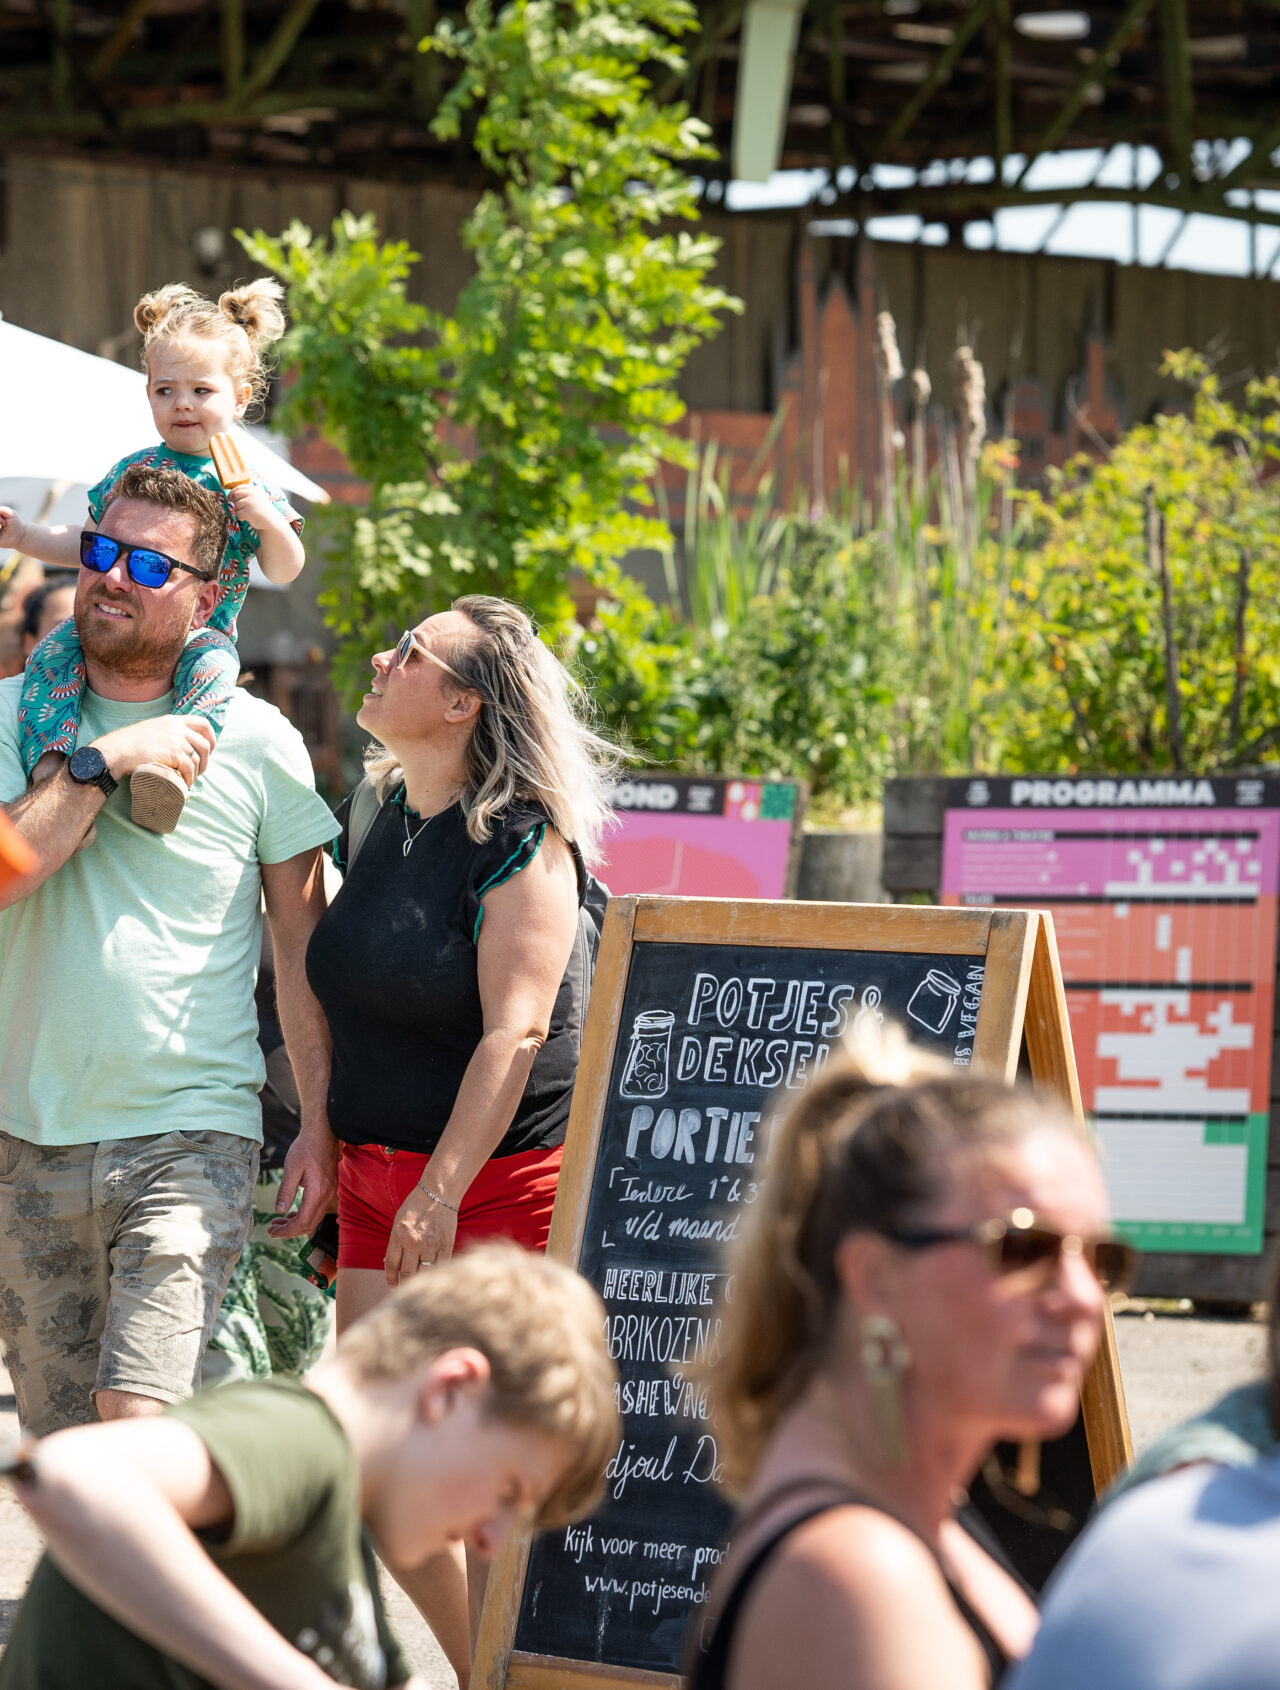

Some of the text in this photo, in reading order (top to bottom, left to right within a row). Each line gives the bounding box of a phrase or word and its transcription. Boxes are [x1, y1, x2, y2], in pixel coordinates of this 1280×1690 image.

[1011, 780, 1217, 806] PROGRAMMA
[958, 965, 985, 1038] VEGAN
[603, 1268, 716, 1306] HEERLIJKE
[601, 1435, 674, 1500] djoul
[564, 1524, 731, 1582] Kijk voor meer prod
[584, 1575, 713, 1616] www.potjesende
